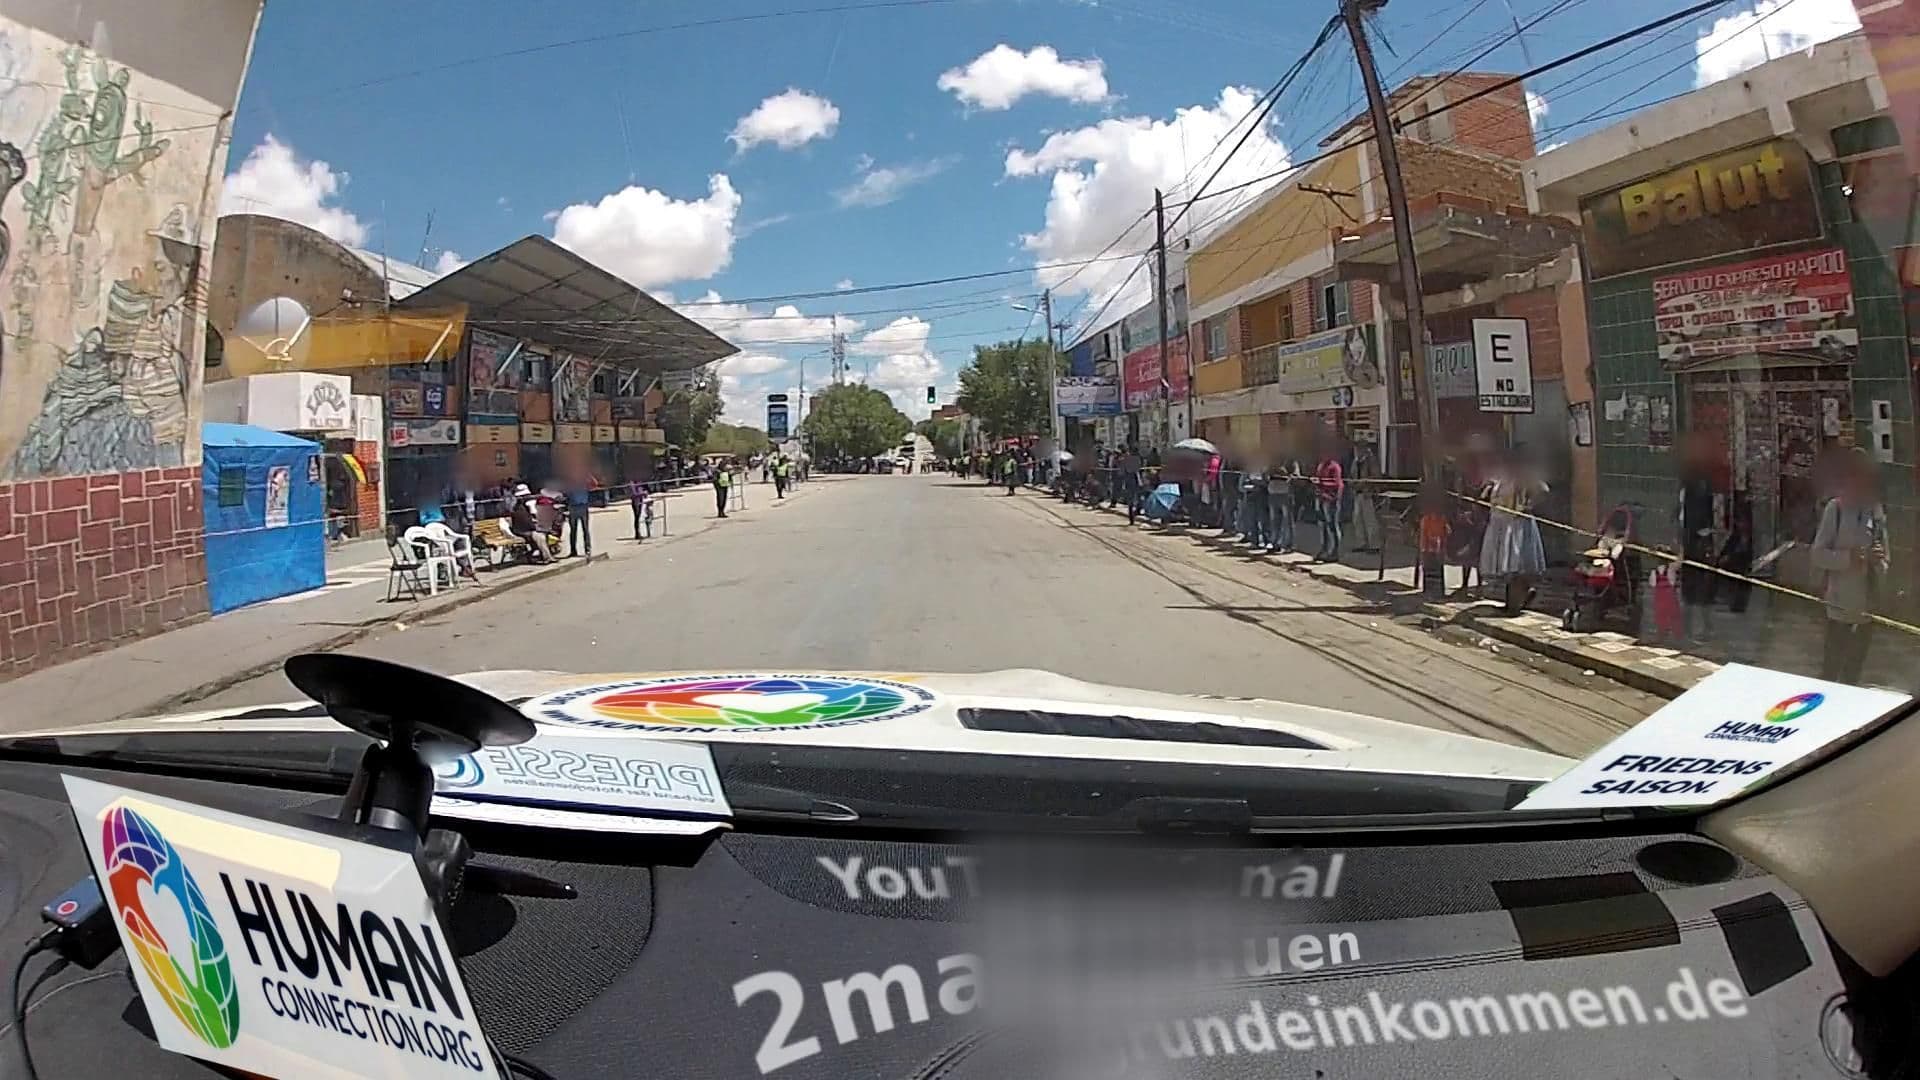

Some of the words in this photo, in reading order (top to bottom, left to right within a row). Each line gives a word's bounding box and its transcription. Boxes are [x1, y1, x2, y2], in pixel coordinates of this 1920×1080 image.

[1620, 144, 1792, 236] Balut
[1654, 275, 1713, 299] SERVICIO
[1715, 264, 1782, 288] EXPRESO
[1783, 250, 1845, 278] RAPIDO
[1490, 334, 1514, 363] E
[1496, 379, 1514, 392] NO
[1712, 720, 1800, 740] HUMAN
[1581, 779, 1720, 795] SAISON.
[1600, 754, 1774, 776] FRIEDENS
[816, 855, 985, 900] YouT
[1237, 852, 1346, 899] nal
[220, 871, 466, 1021] HUMAN
[261, 976, 485, 1073] CONNECTION.ORG
[733, 949, 986, 1076] 2ma
[1128, 967, 1750, 1062] rundeinkommen.de
